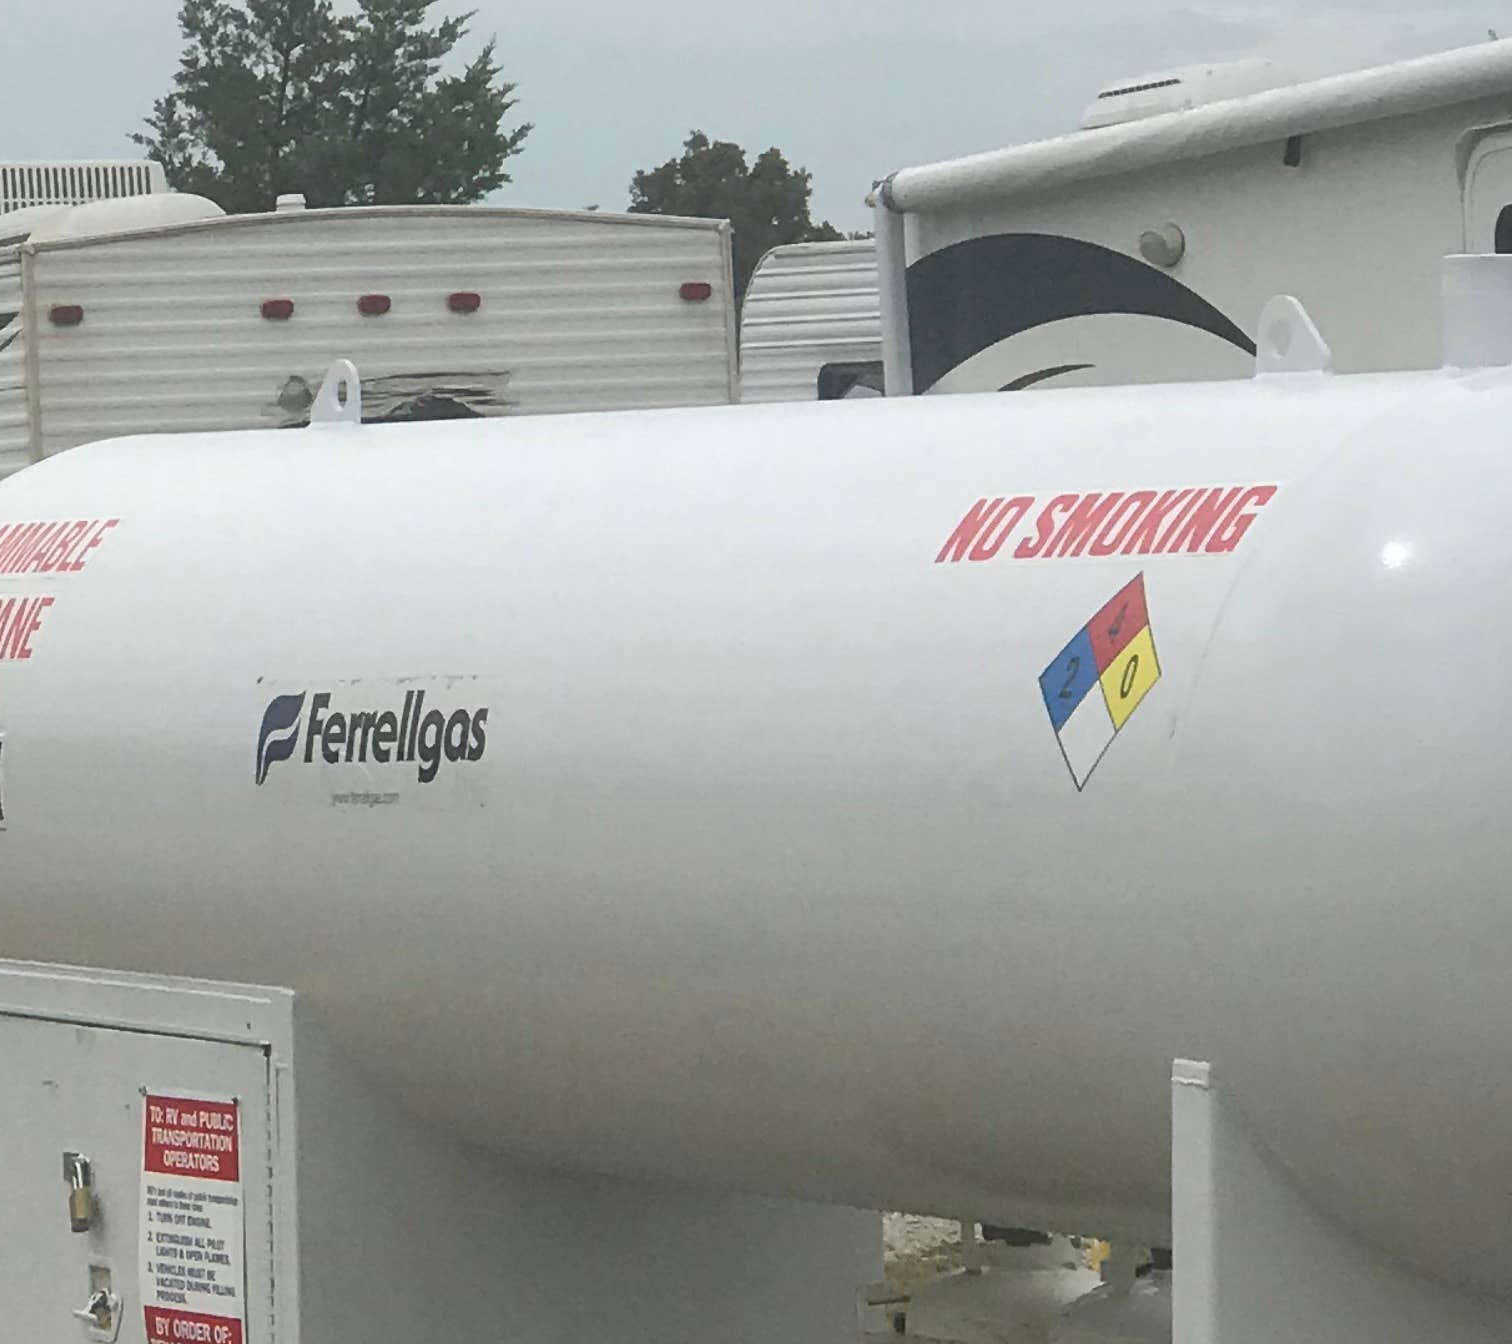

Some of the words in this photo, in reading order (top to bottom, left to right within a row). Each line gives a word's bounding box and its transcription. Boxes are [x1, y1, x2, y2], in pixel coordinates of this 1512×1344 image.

[934, 496, 1036, 563] NO
[1013, 485, 1278, 559] SMOKING
[1058, 656, 1080, 699] 2
[1120, 654, 1139, 699] 0
[303, 690, 489, 783] Ferrellgas
[149, 1106, 164, 1124] TO:
[165, 1107, 179, 1125] RV
[180, 1110, 197, 1127] and
[199, 1111, 234, 1131] PUBLIC
[151, 1127, 232, 1152] TRANSPORTATION
[163, 1150, 220, 1172] OPERATORS
[155, 1316, 170, 1337] BY
[173, 1319, 211, 1343] ORDER
